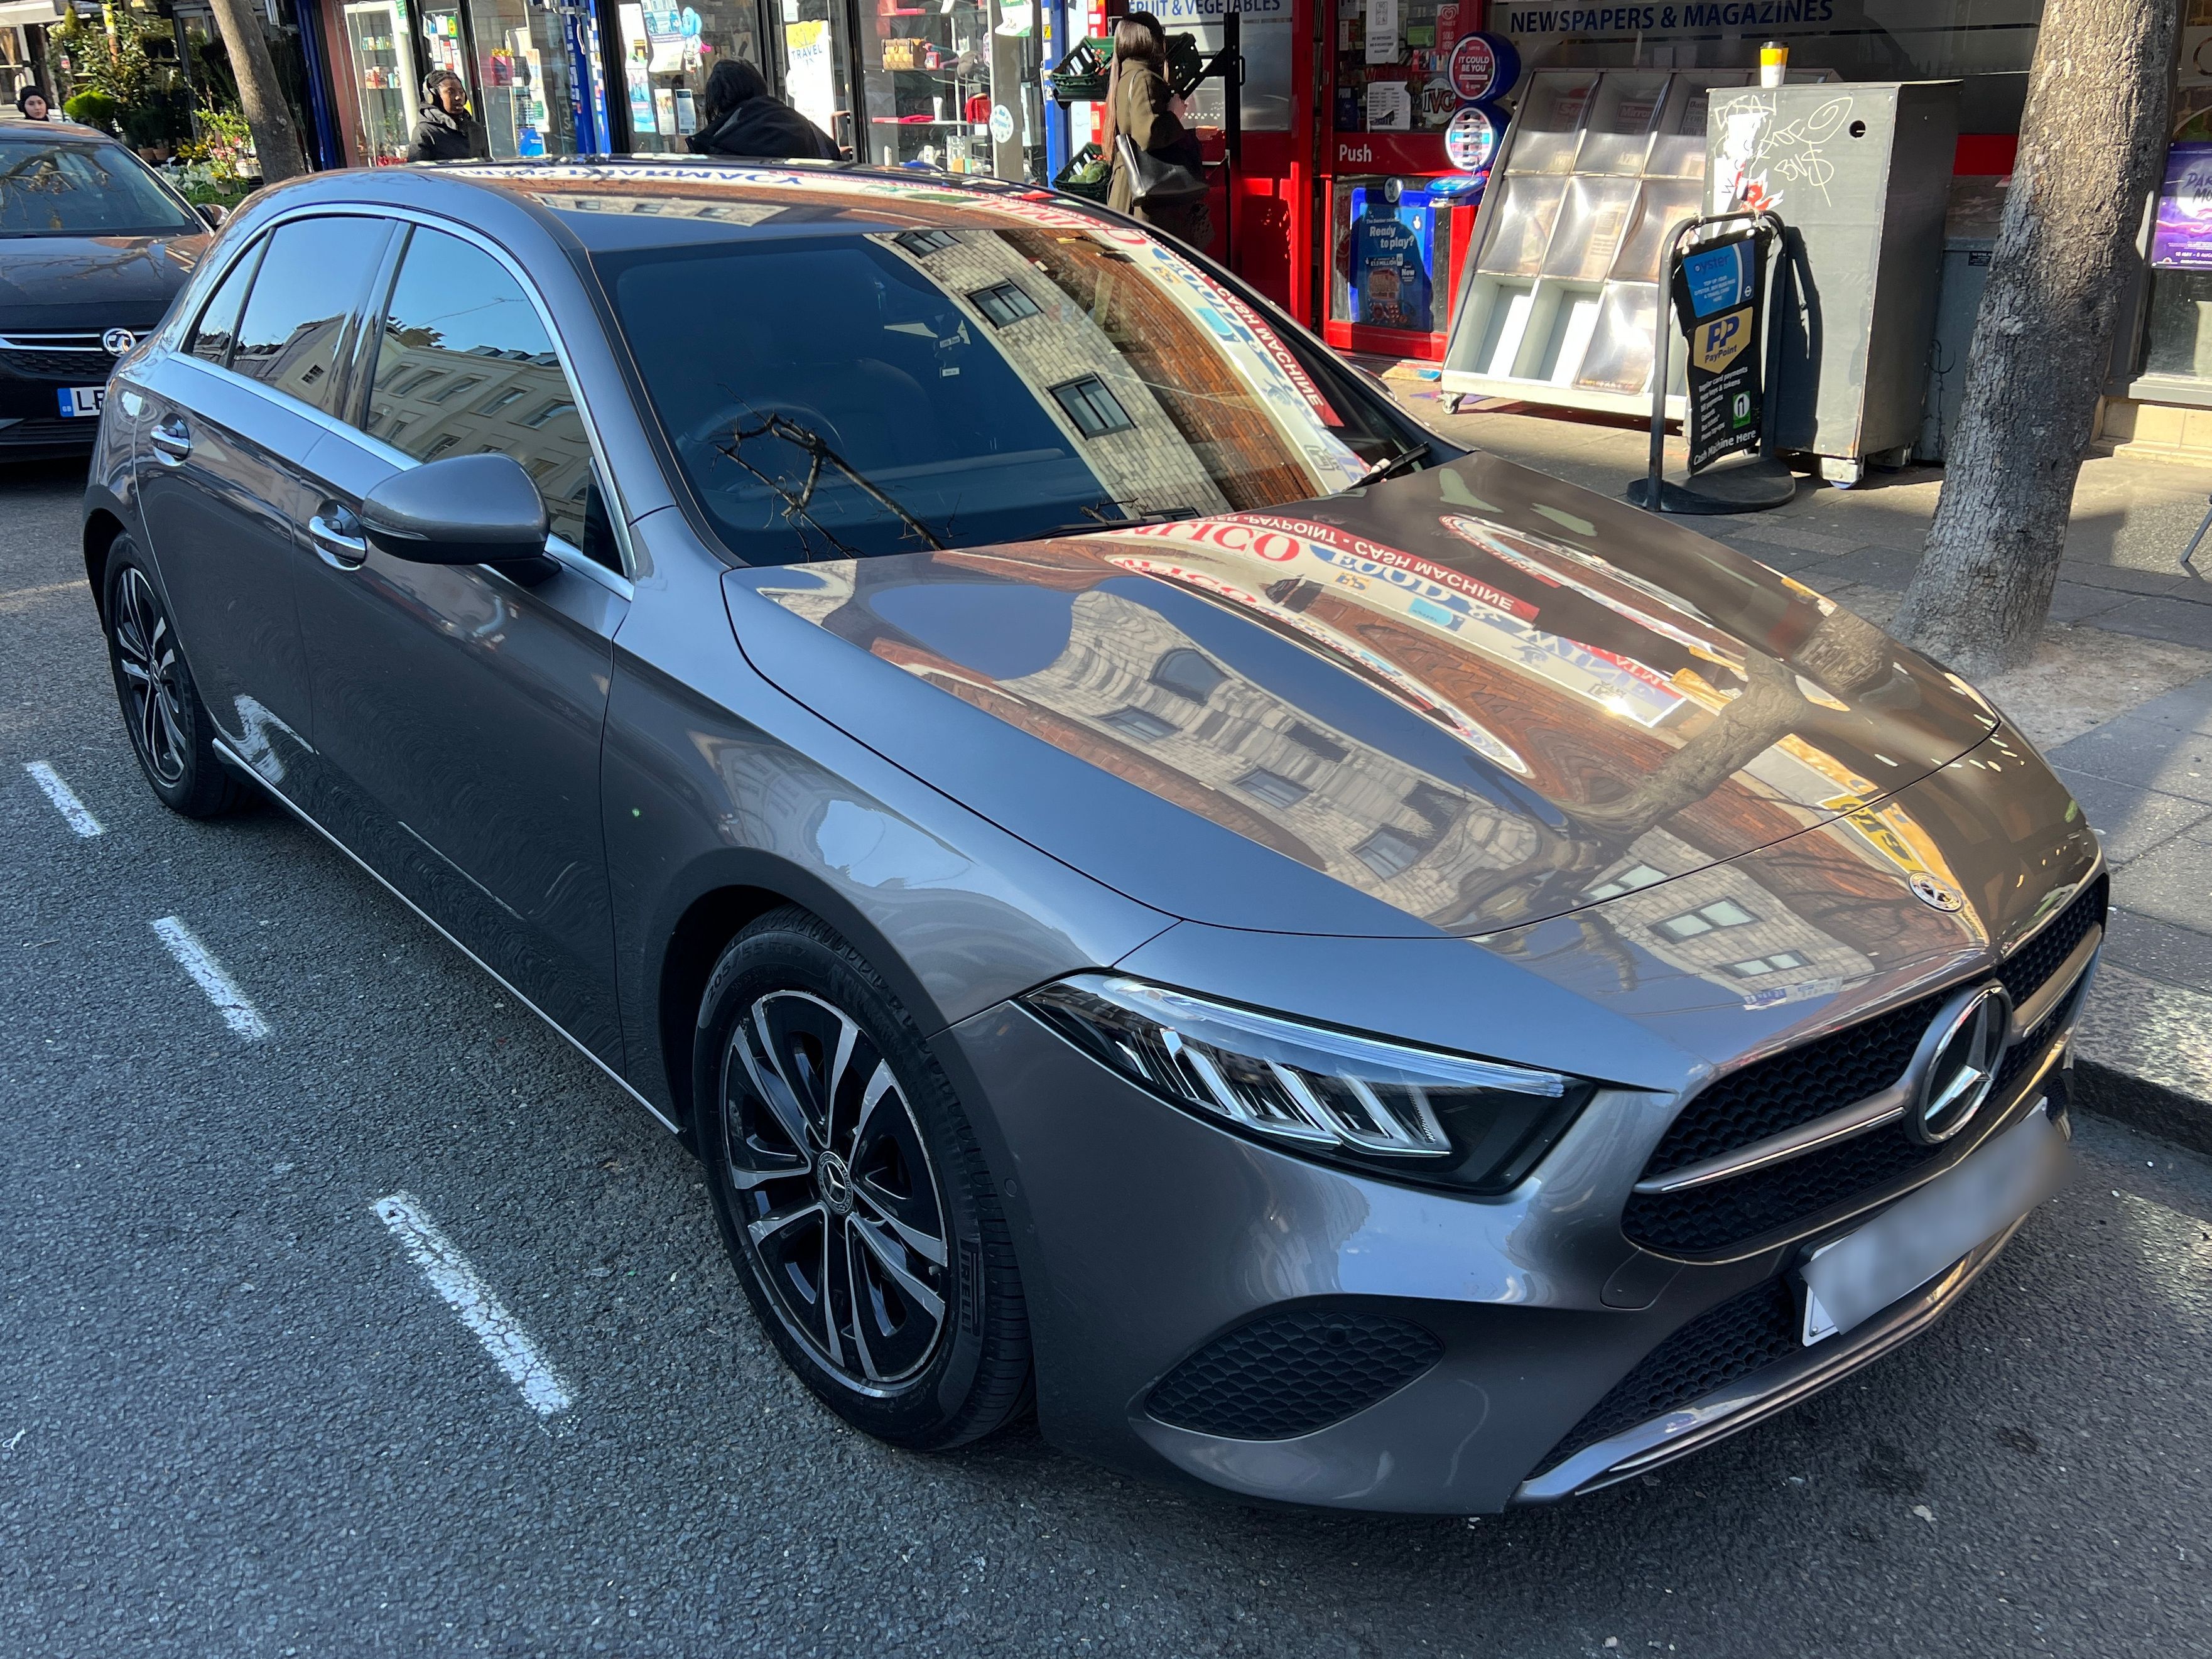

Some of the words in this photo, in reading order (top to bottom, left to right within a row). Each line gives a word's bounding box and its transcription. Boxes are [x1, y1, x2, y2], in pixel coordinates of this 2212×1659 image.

[1172, 0, 1182, 16] &
[1186, 0, 1281, 14] VEGETABLES
[1510, 7, 1655, 33] NEWSPAPERS
[1661, 9, 1678, 28] &
[1683, 0, 1833, 28] MAGAZINES
[791, 43, 823, 61] TRAVEL
[1461, 64, 1470, 72] BE
[1471, 64, 1486, 72] YOU
[1339, 144, 1372, 162] Push
[1370, 225, 1396, 239] Ready
[1380, 238, 1389, 249] to
[1389, 235, 1414, 251] play?
[1694, 254, 1729, 275] oyster
[1705, 345, 1737, 364] PayPoint
[1693, 450, 1708, 465] Cash
[1708, 436, 1735, 457] Machine
[1736, 430, 1757, 444] Here
